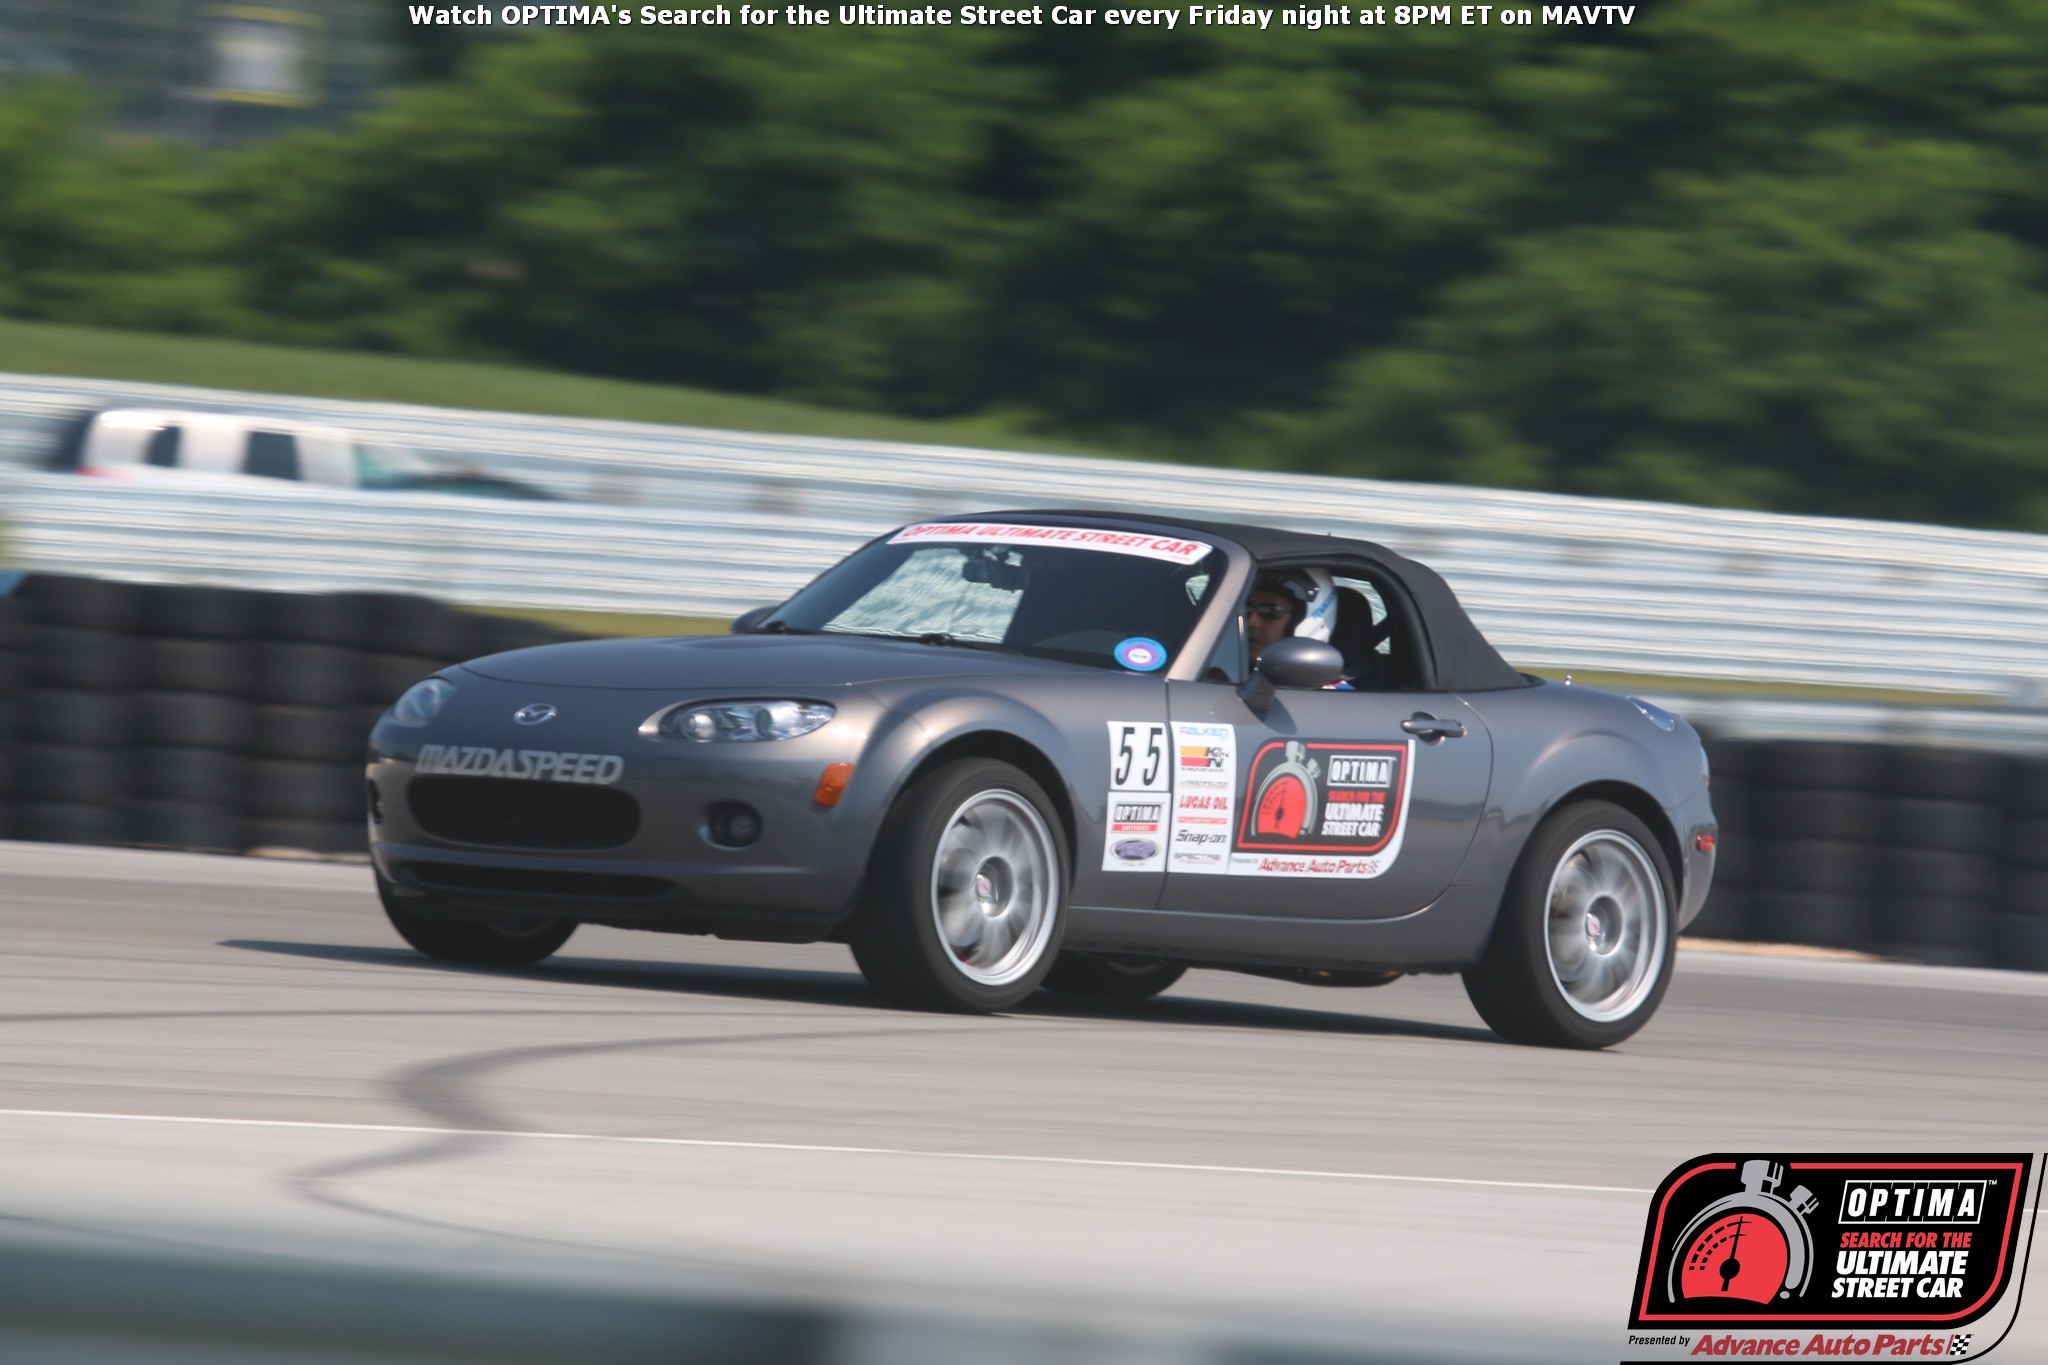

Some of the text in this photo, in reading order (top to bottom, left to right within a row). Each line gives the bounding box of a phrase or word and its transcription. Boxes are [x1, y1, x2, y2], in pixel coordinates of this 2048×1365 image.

[902, 525, 1200, 555] OPTIMA ULTIMATE STREET CAR
[414, 744, 625, 785] MAZDASPEED
[1332, 760, 1389, 783] OPTIMA
[1178, 795, 1228, 810] LUCAS OIL
[1115, 805, 1160, 822] OPTIMA
[1324, 802, 1385, 822] ULTIMATE
[1176, 829, 1227, 845] Snap-on
[1321, 820, 1382, 838] STREET CAR
[1258, 858, 1306, 873] Advance
[1307, 860, 1337, 874] Auto
[1335, 860, 1369, 875] Parts
